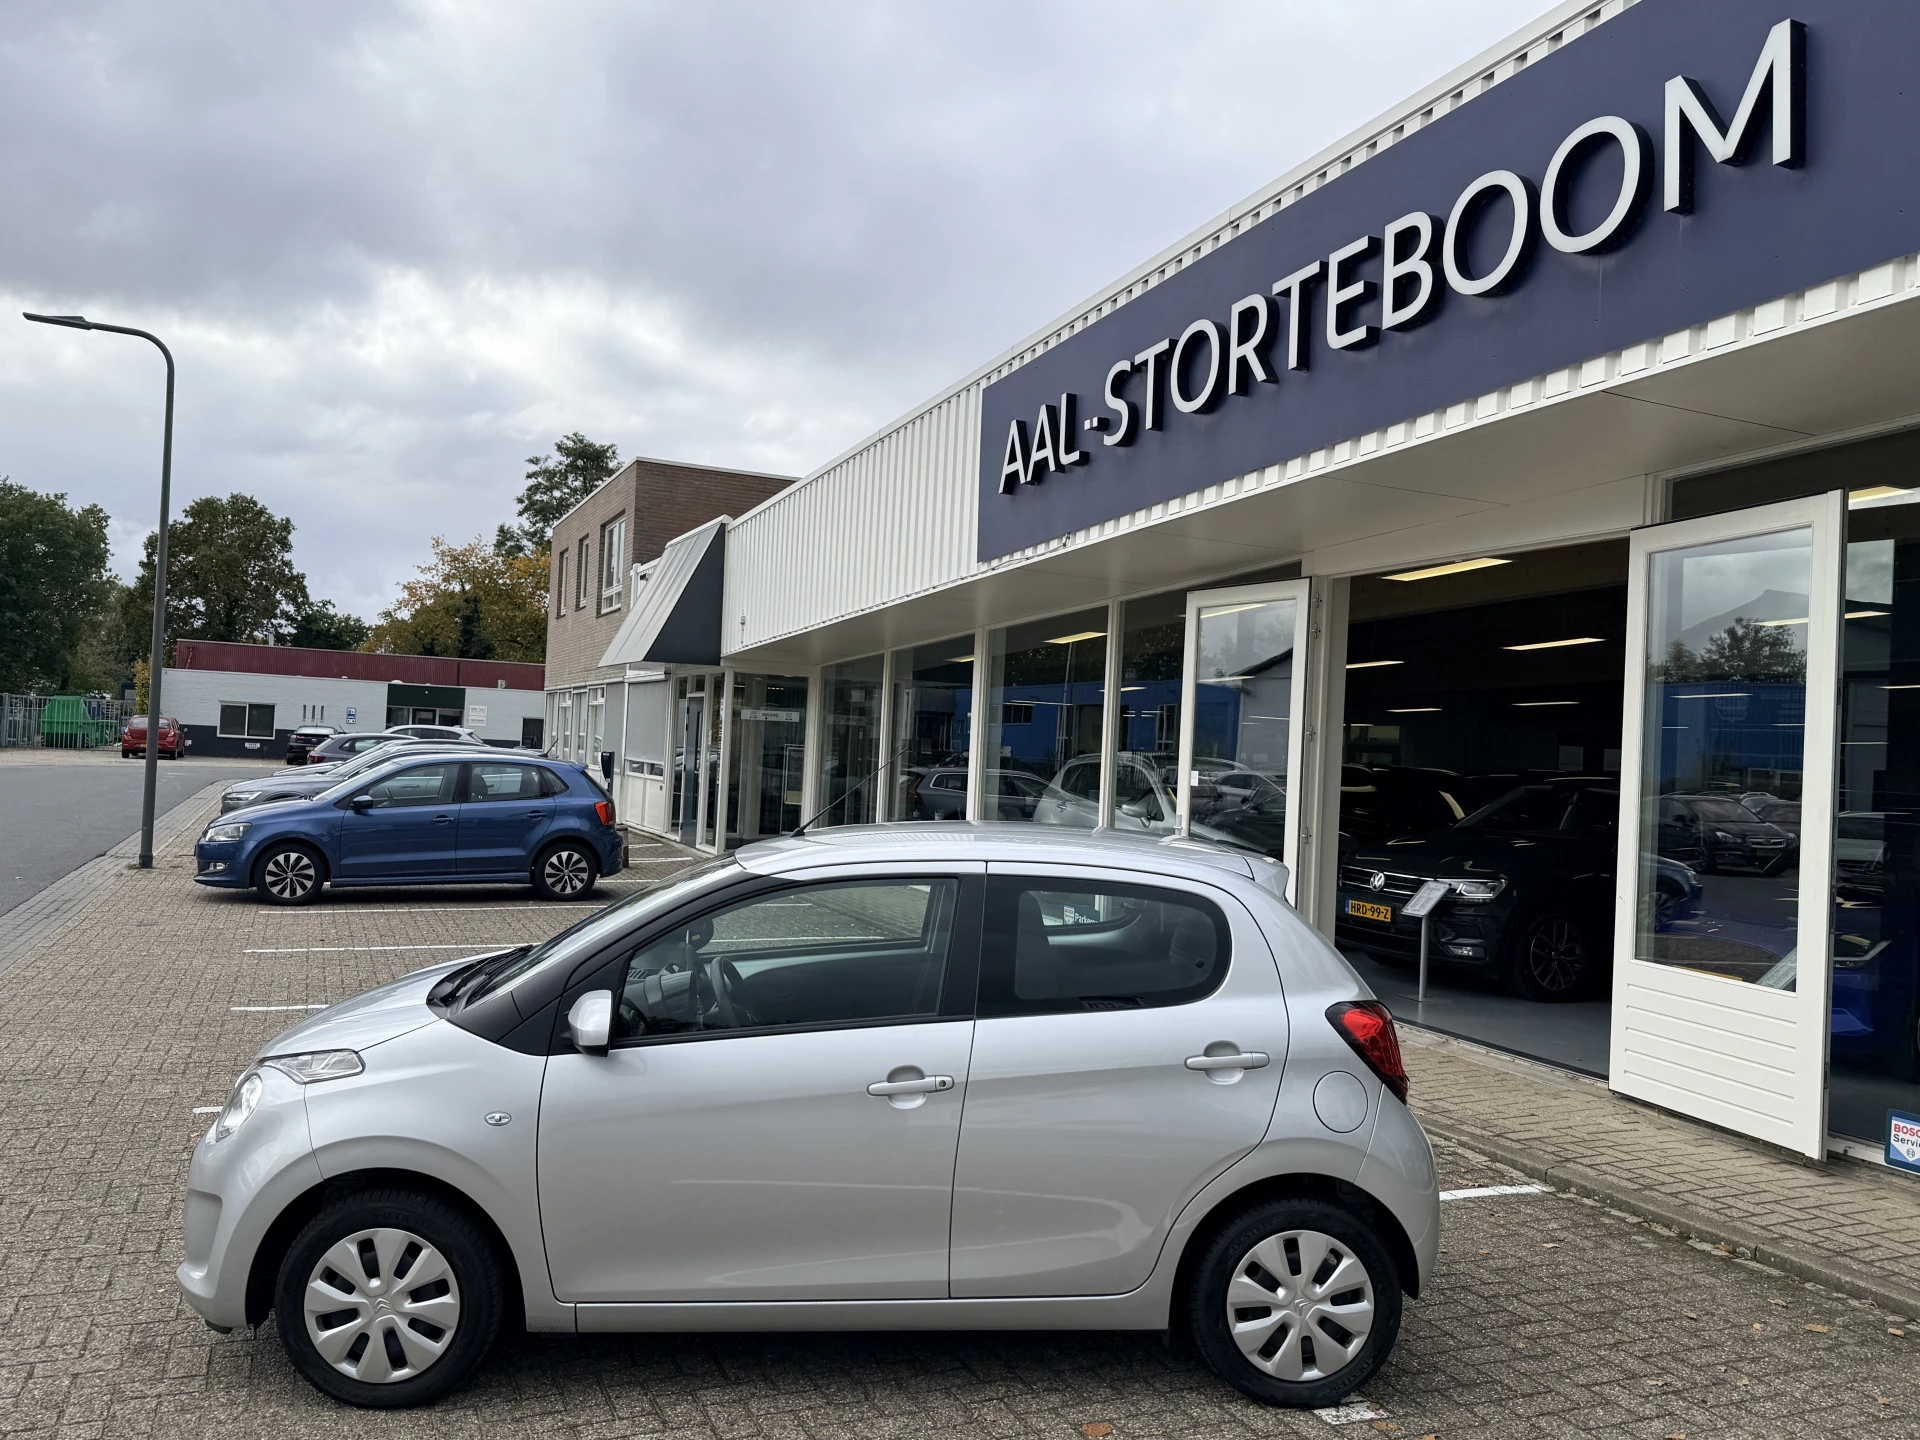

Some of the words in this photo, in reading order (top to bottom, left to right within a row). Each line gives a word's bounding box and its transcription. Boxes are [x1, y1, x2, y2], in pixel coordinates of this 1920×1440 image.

[999, 19, 1802, 494] AAL-STORTEBOOM
[1350, 901, 1390, 920] HRD-99-Z
[1893, 1134, 1920, 1148] Servi
